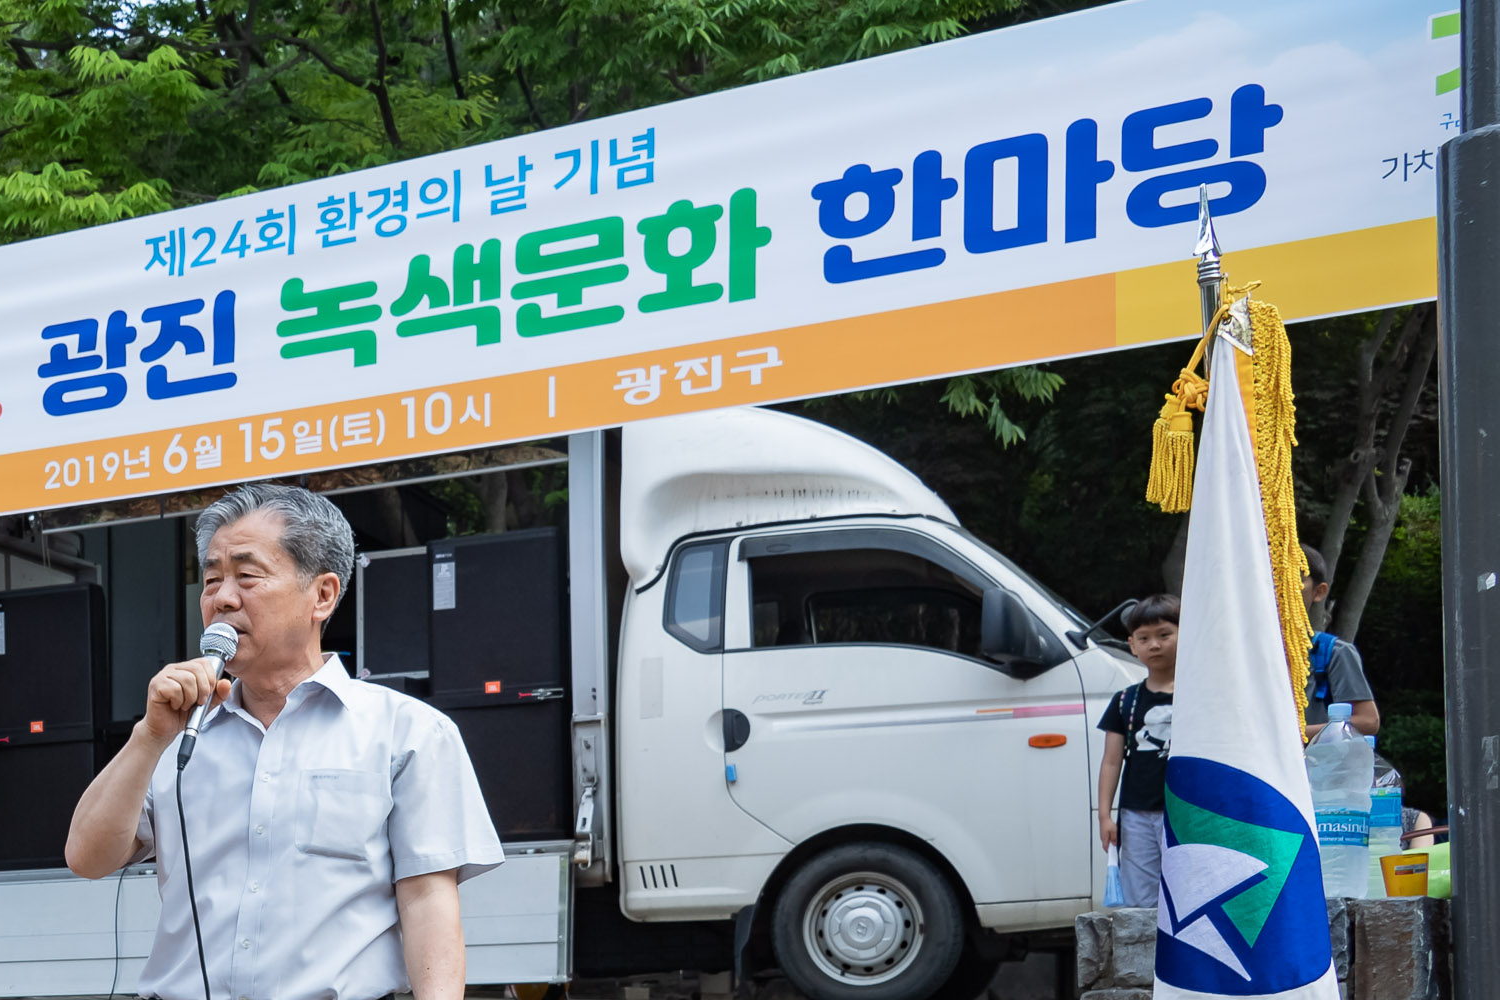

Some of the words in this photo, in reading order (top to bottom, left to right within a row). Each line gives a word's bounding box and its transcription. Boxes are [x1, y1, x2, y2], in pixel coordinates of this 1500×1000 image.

[37, 289, 238, 417] 광진
[276, 187, 772, 368] 녹색문화
[810, 83, 1284, 285] 한마당
[144, 204, 298, 278] 제24회
[314, 169, 462, 249] 환경의
[484, 155, 534, 217] 날
[552, 126, 657, 196] 기념
[44, 446, 151, 490] 2019년
[162, 432, 223, 476] 6월
[238, 408, 386, 464] 15일(토)
[400, 391, 492, 440] 10시
[612, 345, 784, 406] 광진구
